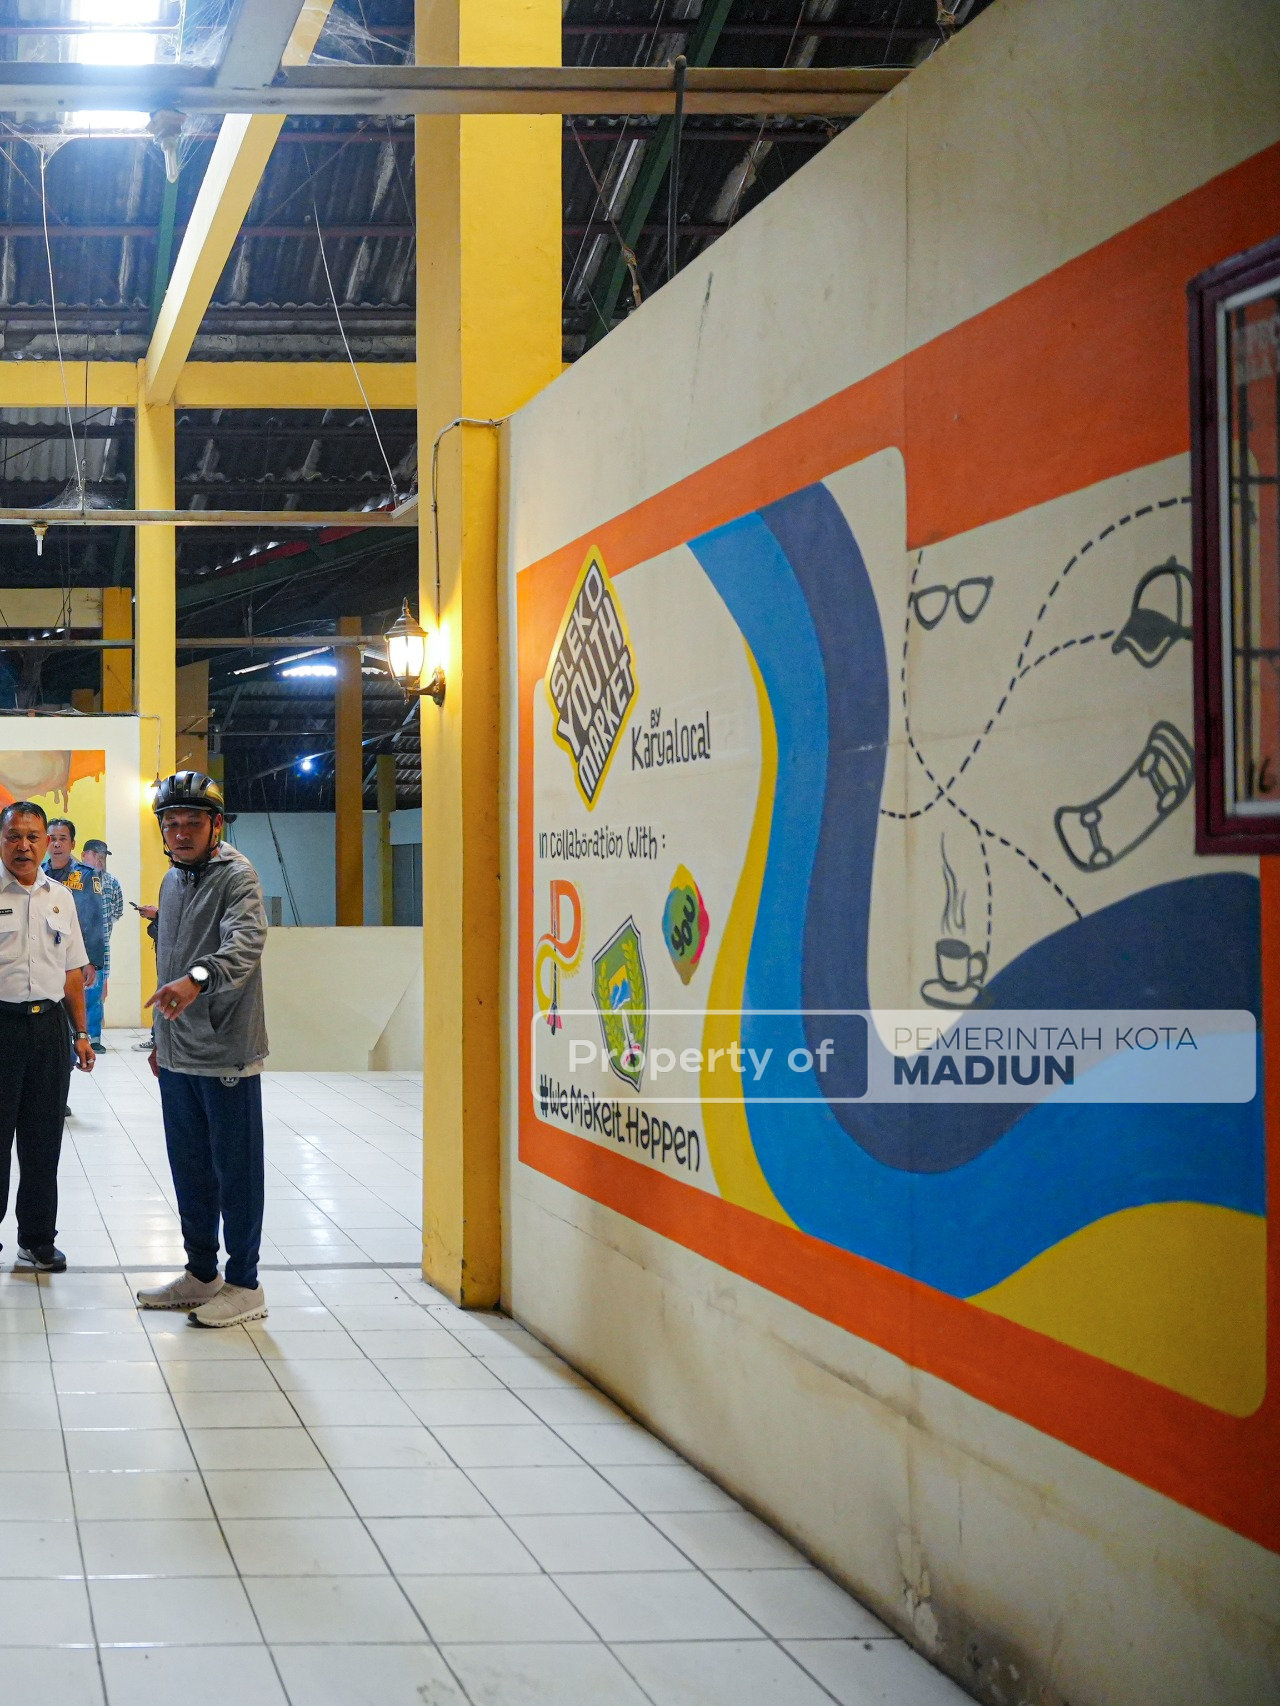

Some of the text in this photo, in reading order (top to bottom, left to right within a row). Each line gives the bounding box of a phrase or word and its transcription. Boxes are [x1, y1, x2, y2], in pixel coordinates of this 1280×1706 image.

[551, 564, 603, 708] SLEKO
[557, 596, 623, 757] YOUTH
[578, 650, 633, 798] MARKET
[650, 707, 662, 729] BY
